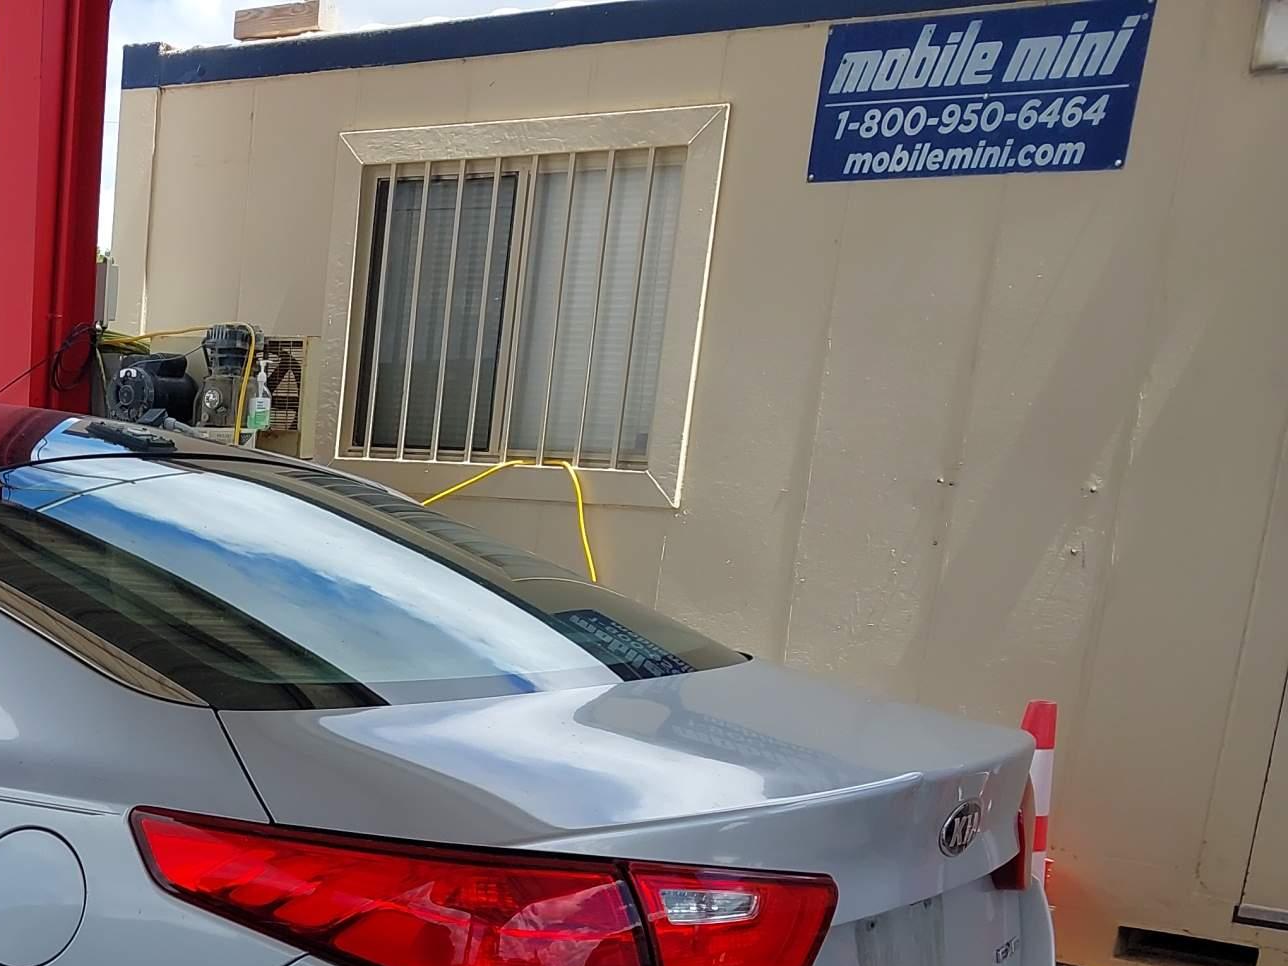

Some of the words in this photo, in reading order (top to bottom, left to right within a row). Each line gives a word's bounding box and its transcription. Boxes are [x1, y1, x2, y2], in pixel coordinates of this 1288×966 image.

[829, 20, 1003, 94] mobile
[1002, 15, 1141, 83] mini
[834, 95, 1110, 140] 1-800-950-6464
[843, 139, 1086, 175] mobilemini.com
